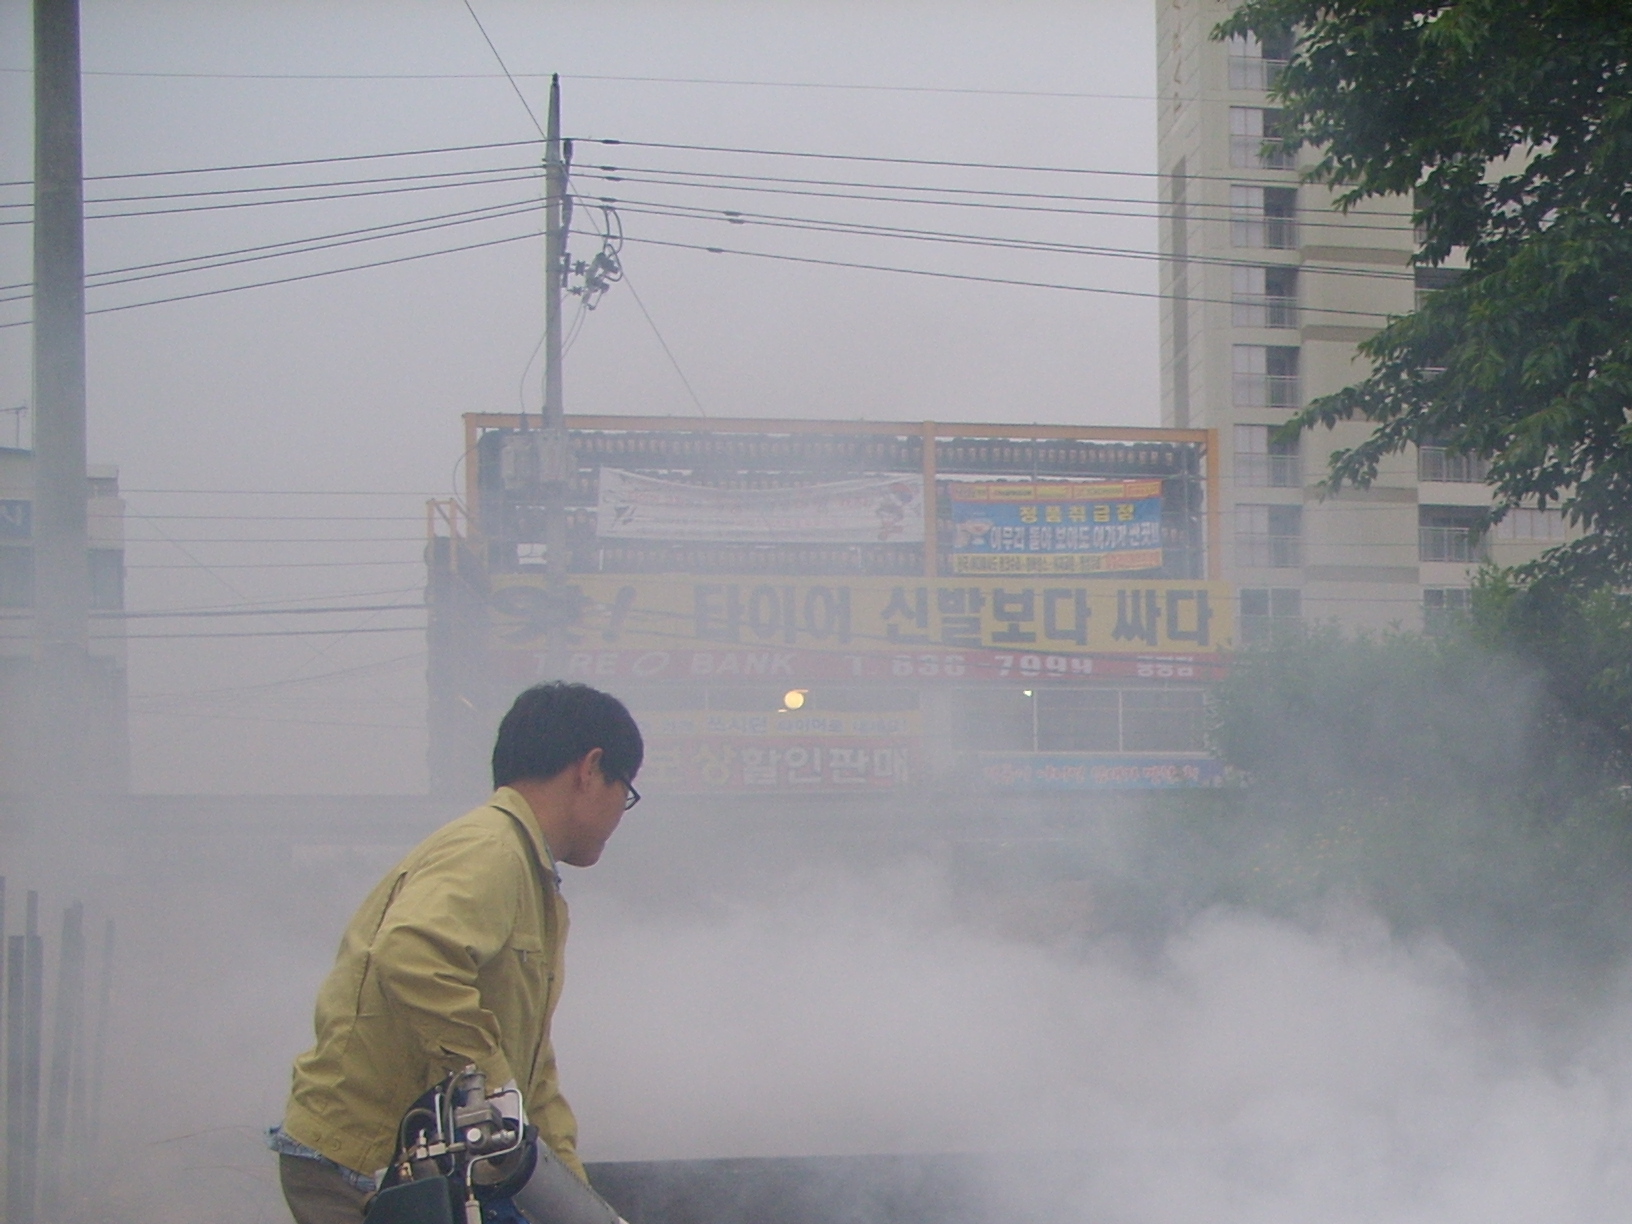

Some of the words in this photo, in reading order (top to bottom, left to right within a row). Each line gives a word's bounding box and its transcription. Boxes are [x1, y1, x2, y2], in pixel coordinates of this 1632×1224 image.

[693, 584, 852, 644] 타이어
[880, 586, 1093, 648] 신발보다
[1111, 588, 1215, 647] 싸다
[534, 653, 619, 676] TRE
[691, 651, 798, 676] BANK
